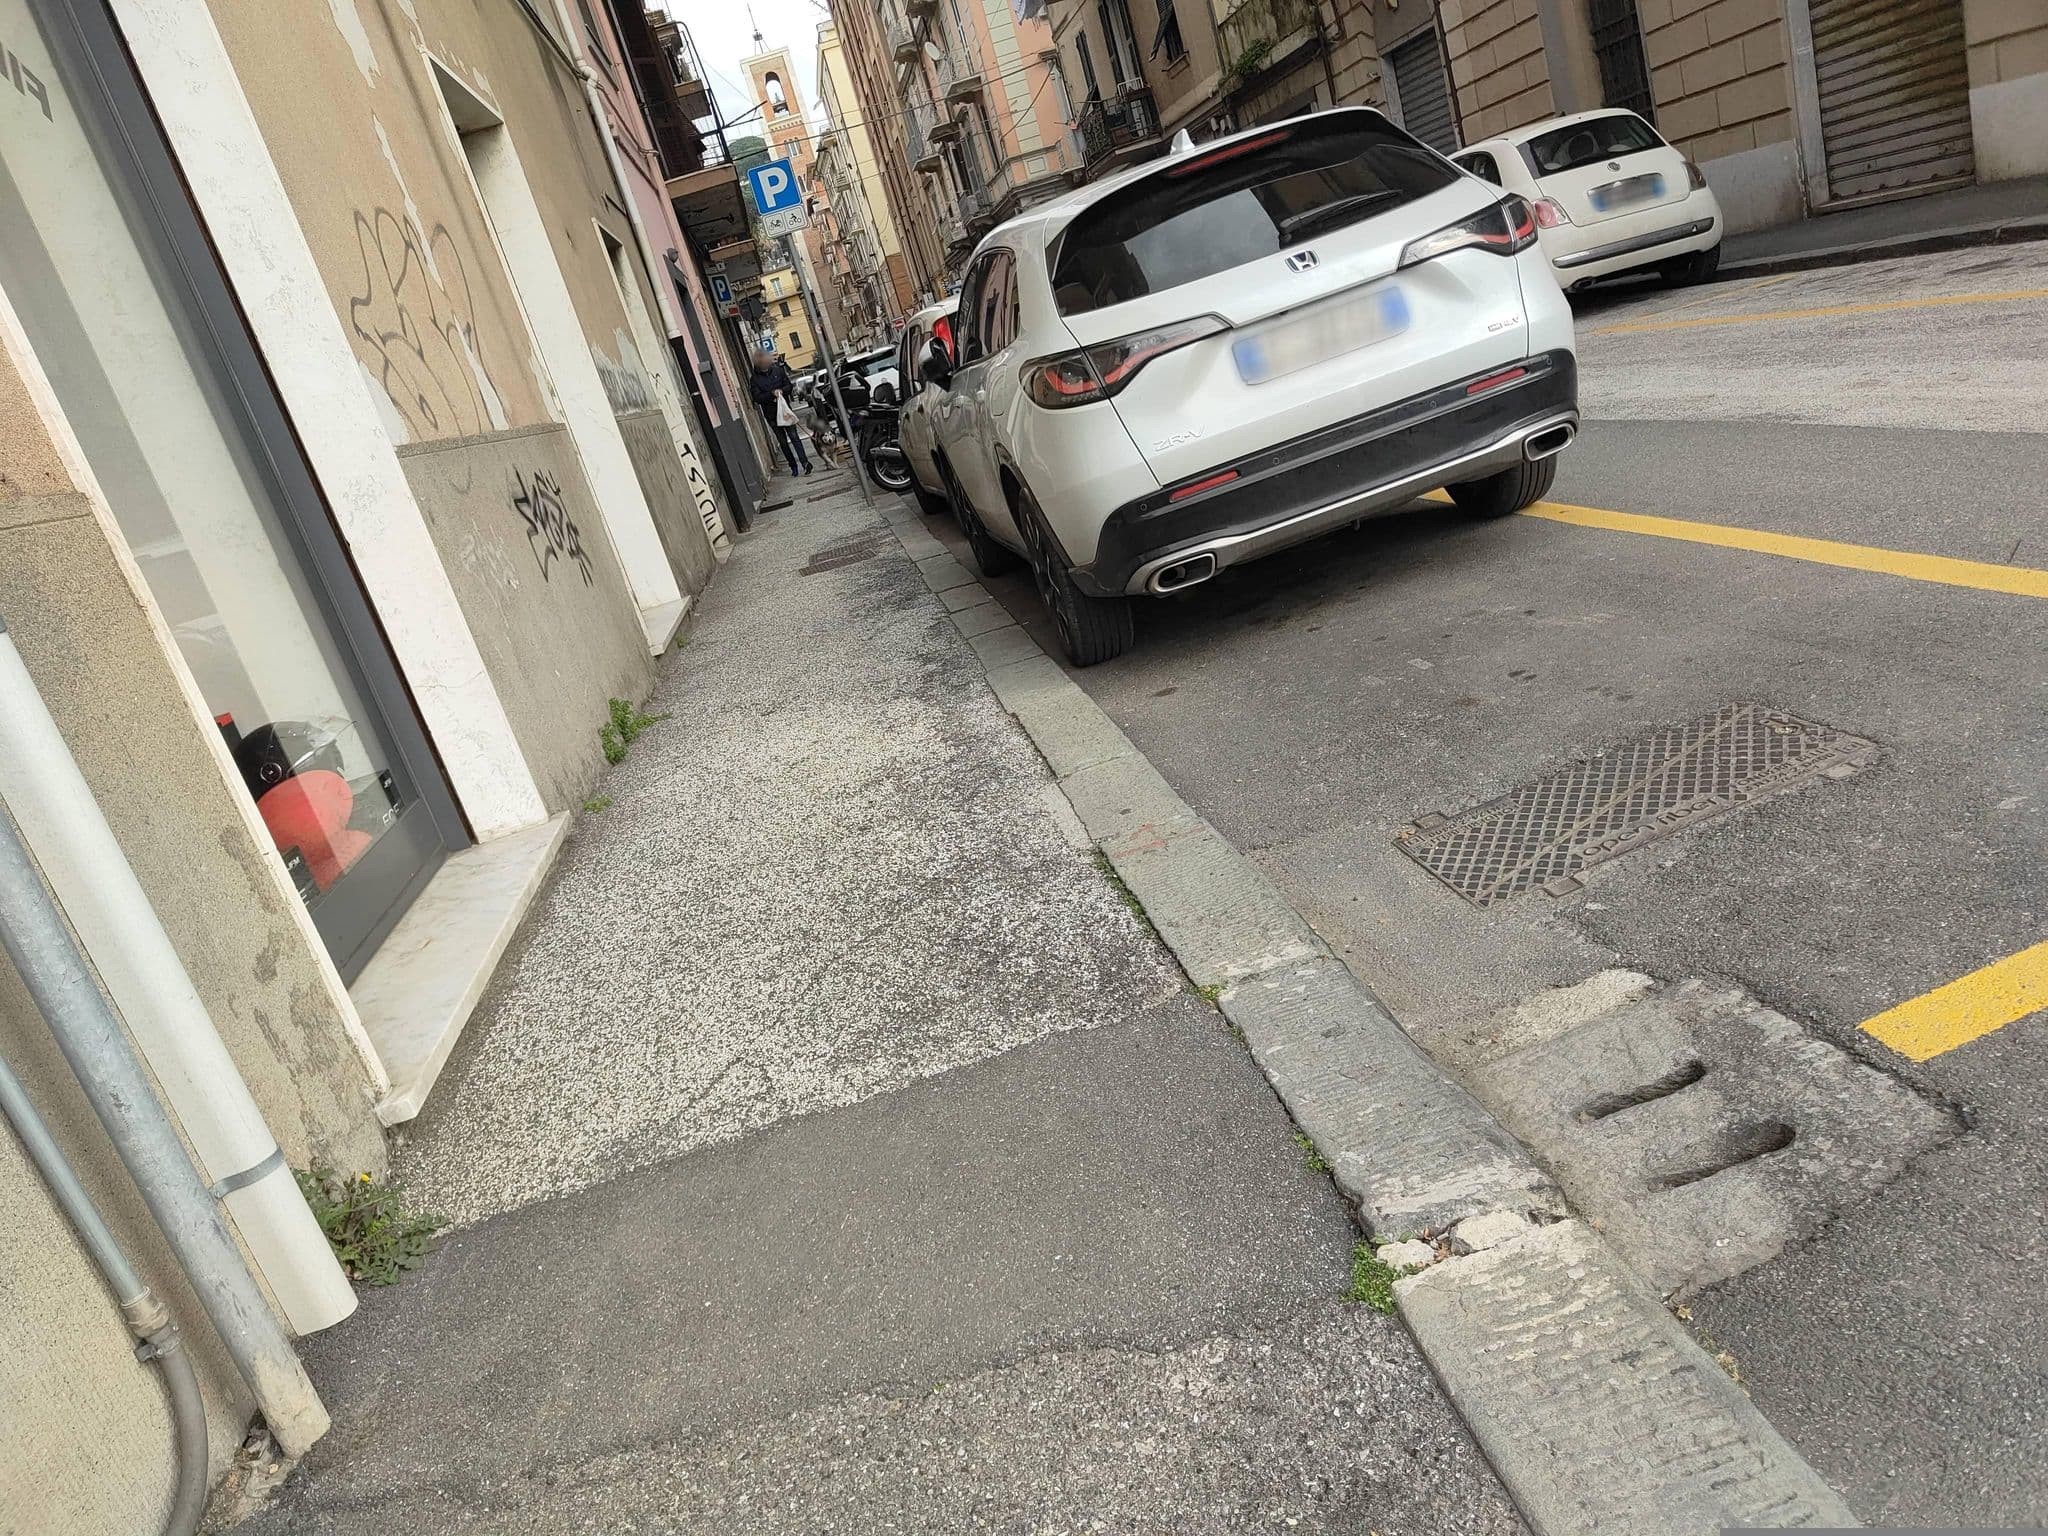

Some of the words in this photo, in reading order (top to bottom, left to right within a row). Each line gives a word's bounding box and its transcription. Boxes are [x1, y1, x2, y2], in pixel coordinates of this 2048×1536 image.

[758, 167, 788, 208] P
[716, 279, 727, 300] P
[762, 340, 770, 352] P
[1583, 824, 1656, 856] open
[1657, 797, 1718, 826] fiber
